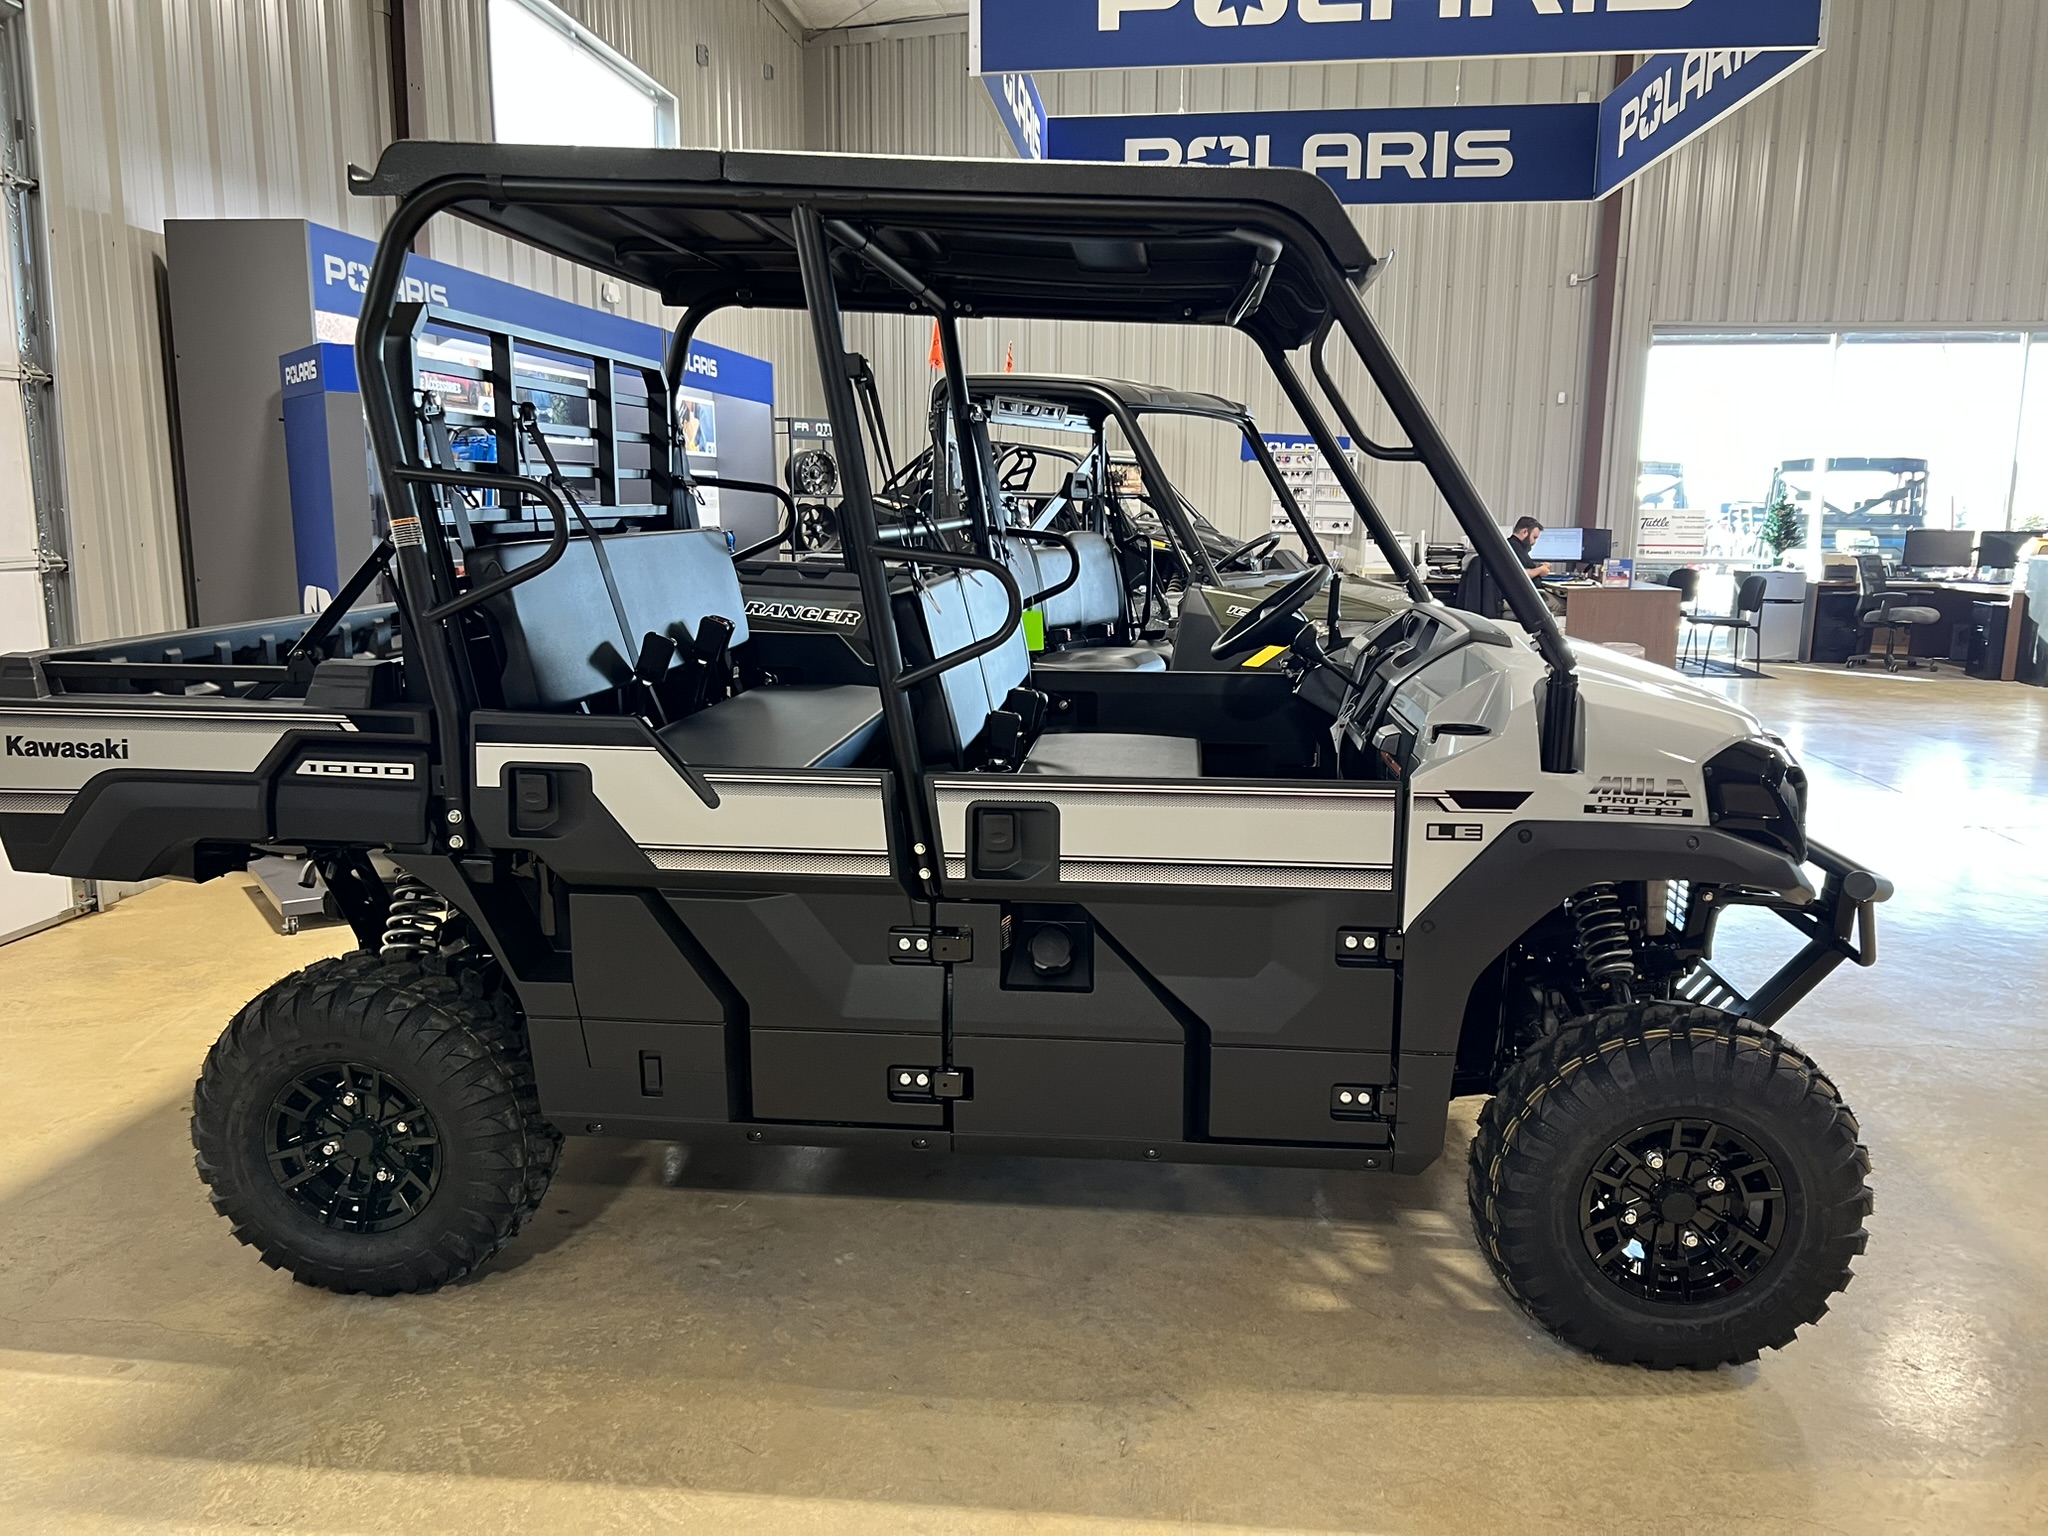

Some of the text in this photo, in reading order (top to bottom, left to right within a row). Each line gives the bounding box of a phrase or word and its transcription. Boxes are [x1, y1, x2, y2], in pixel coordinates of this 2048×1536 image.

[1618, 50, 1763, 158] POLAR
[324, 253, 449, 308] PORIS
[285, 359, 317, 386] POLARIS
[685, 352, 718, 378] LARIS
[1640, 516, 1670, 530] Tuttle
[744, 601, 862, 626] RANGER
[6, 735, 129, 760] Kawasaki
[306, 762, 411, 778] 1000
[1588, 775, 1692, 799] MULE
[1592, 805, 1684, 817] 1000
[1598, 796, 1682, 806] PRO-FXT
[1427, 824, 1482, 840] LE
